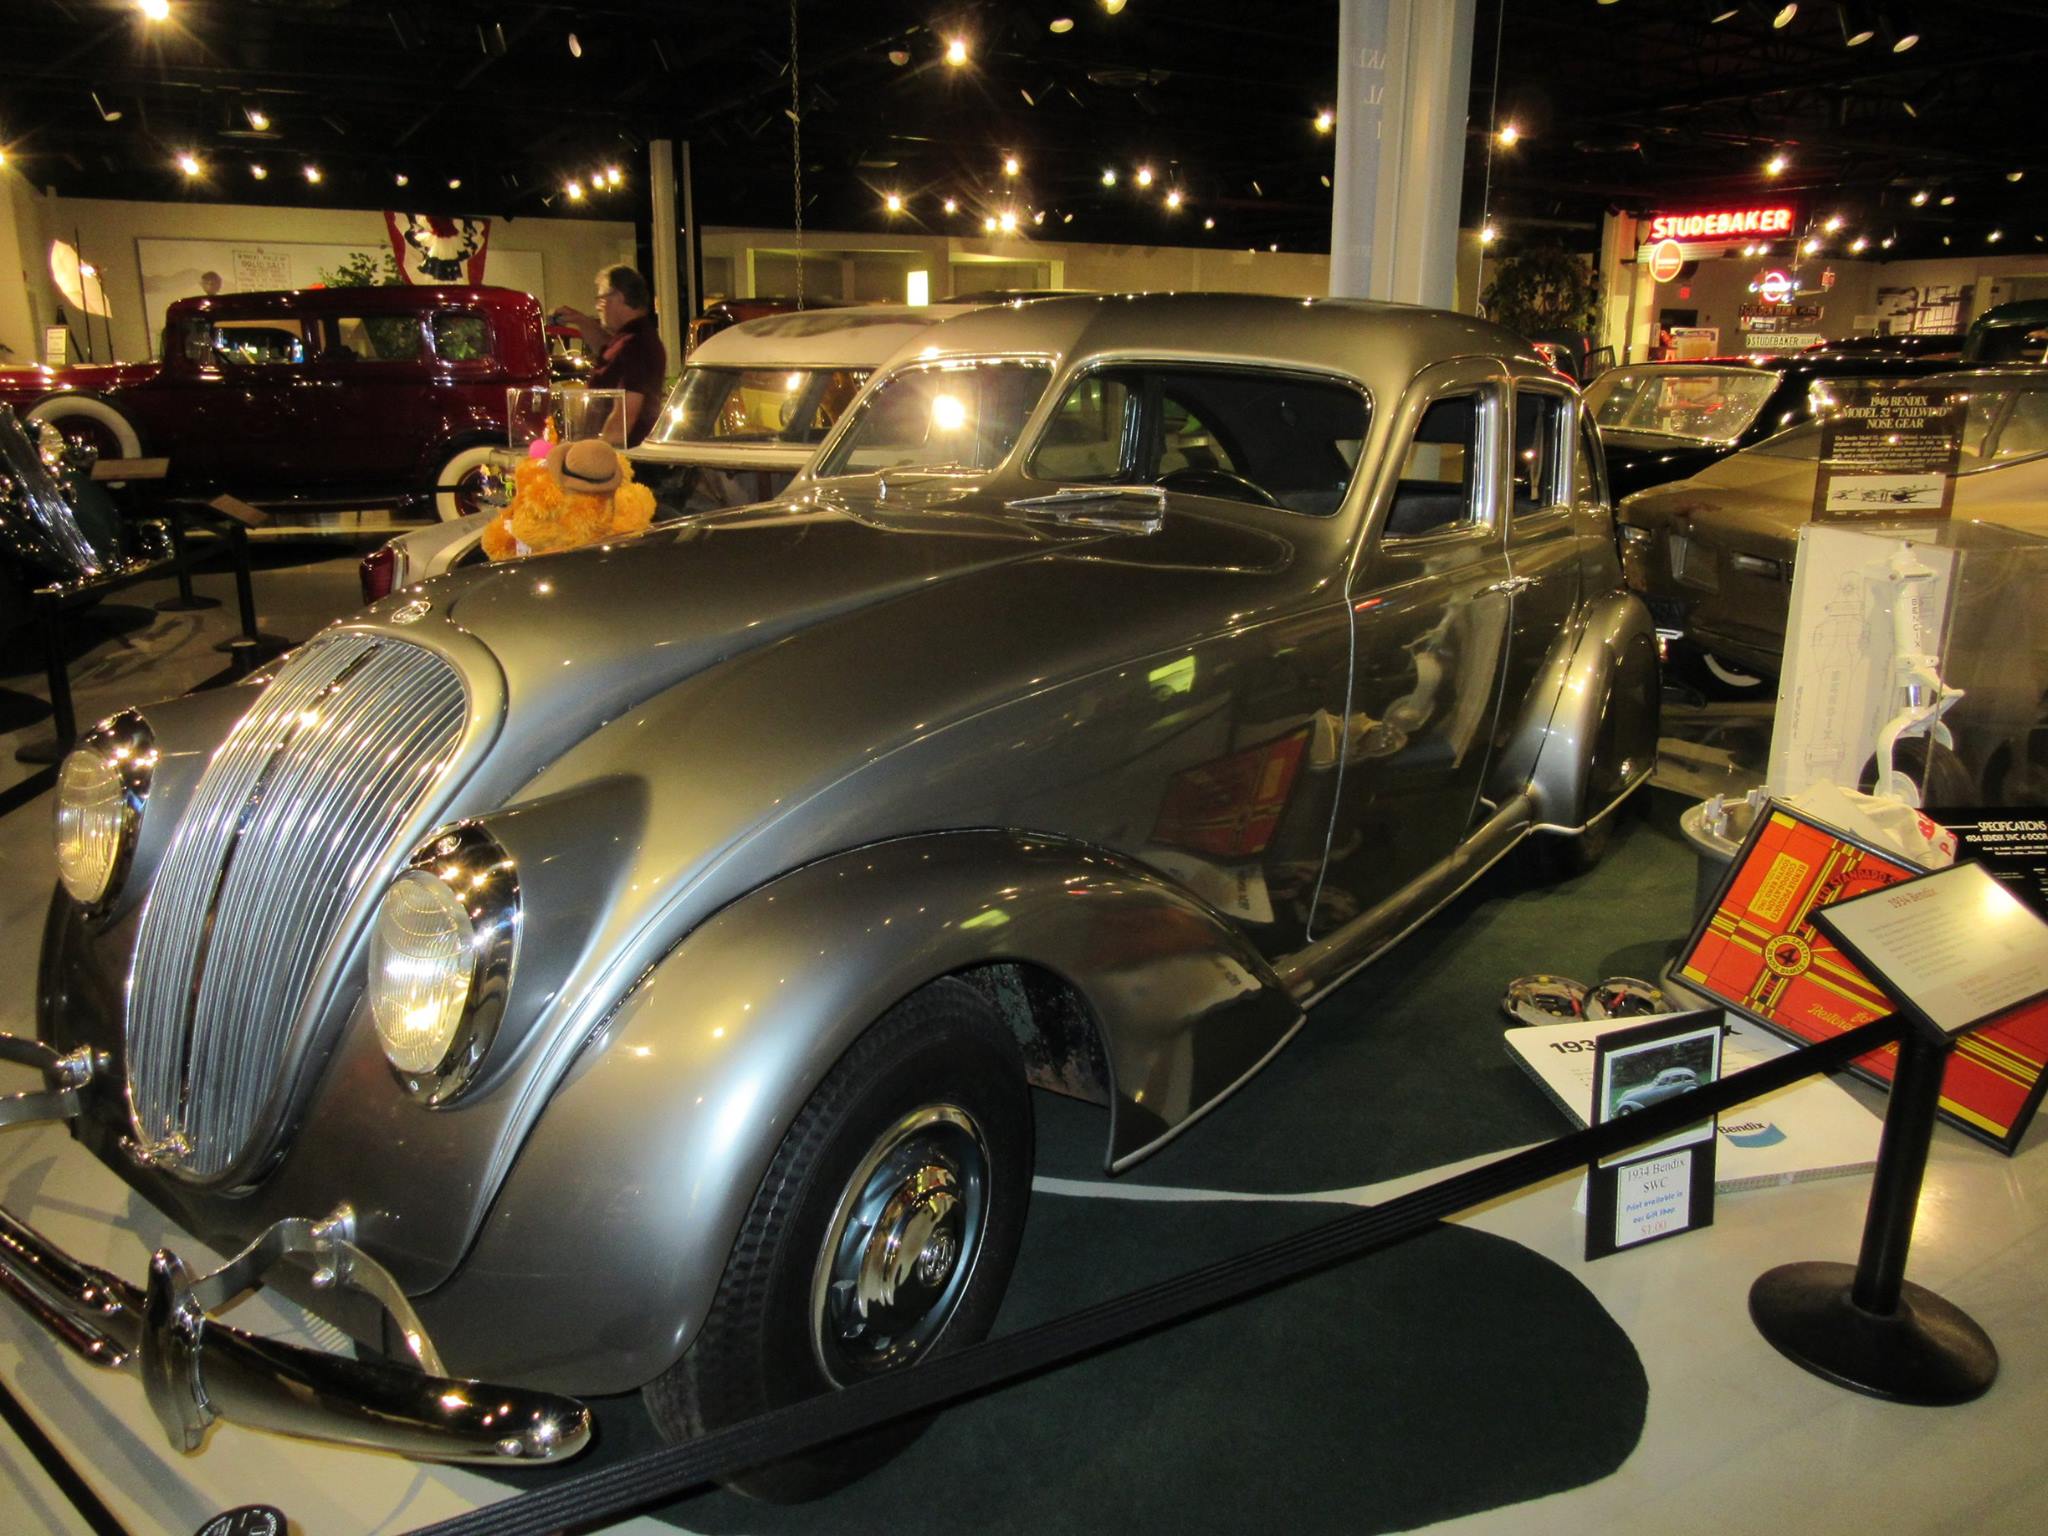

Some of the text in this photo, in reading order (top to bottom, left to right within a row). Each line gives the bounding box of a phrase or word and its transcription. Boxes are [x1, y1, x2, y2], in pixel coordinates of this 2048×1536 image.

[1651, 209, 1791, 239] STUDEBAKER
[1752, 336, 1799, 346] STUDEBAKER
[1870, 395, 1929, 407] 1946 BENDIX
[1843, 407, 1878, 418] MODEL
[1880, 407, 1891, 418] 52
[1866, 418, 1925, 429] NOSE GEAR
[1978, 821, 2047, 832] SPECIFICATIONS
[1774, 947, 1799, 967] 4
[1549, 1039, 1598, 1055] 193
[1717, 1121, 1766, 1136] Bendix
[1627, 1159, 1685, 1181] 1934 Bendix
[1643, 1176, 1669, 1193] SWC
[1644, 1192, 1676, 1207] available
